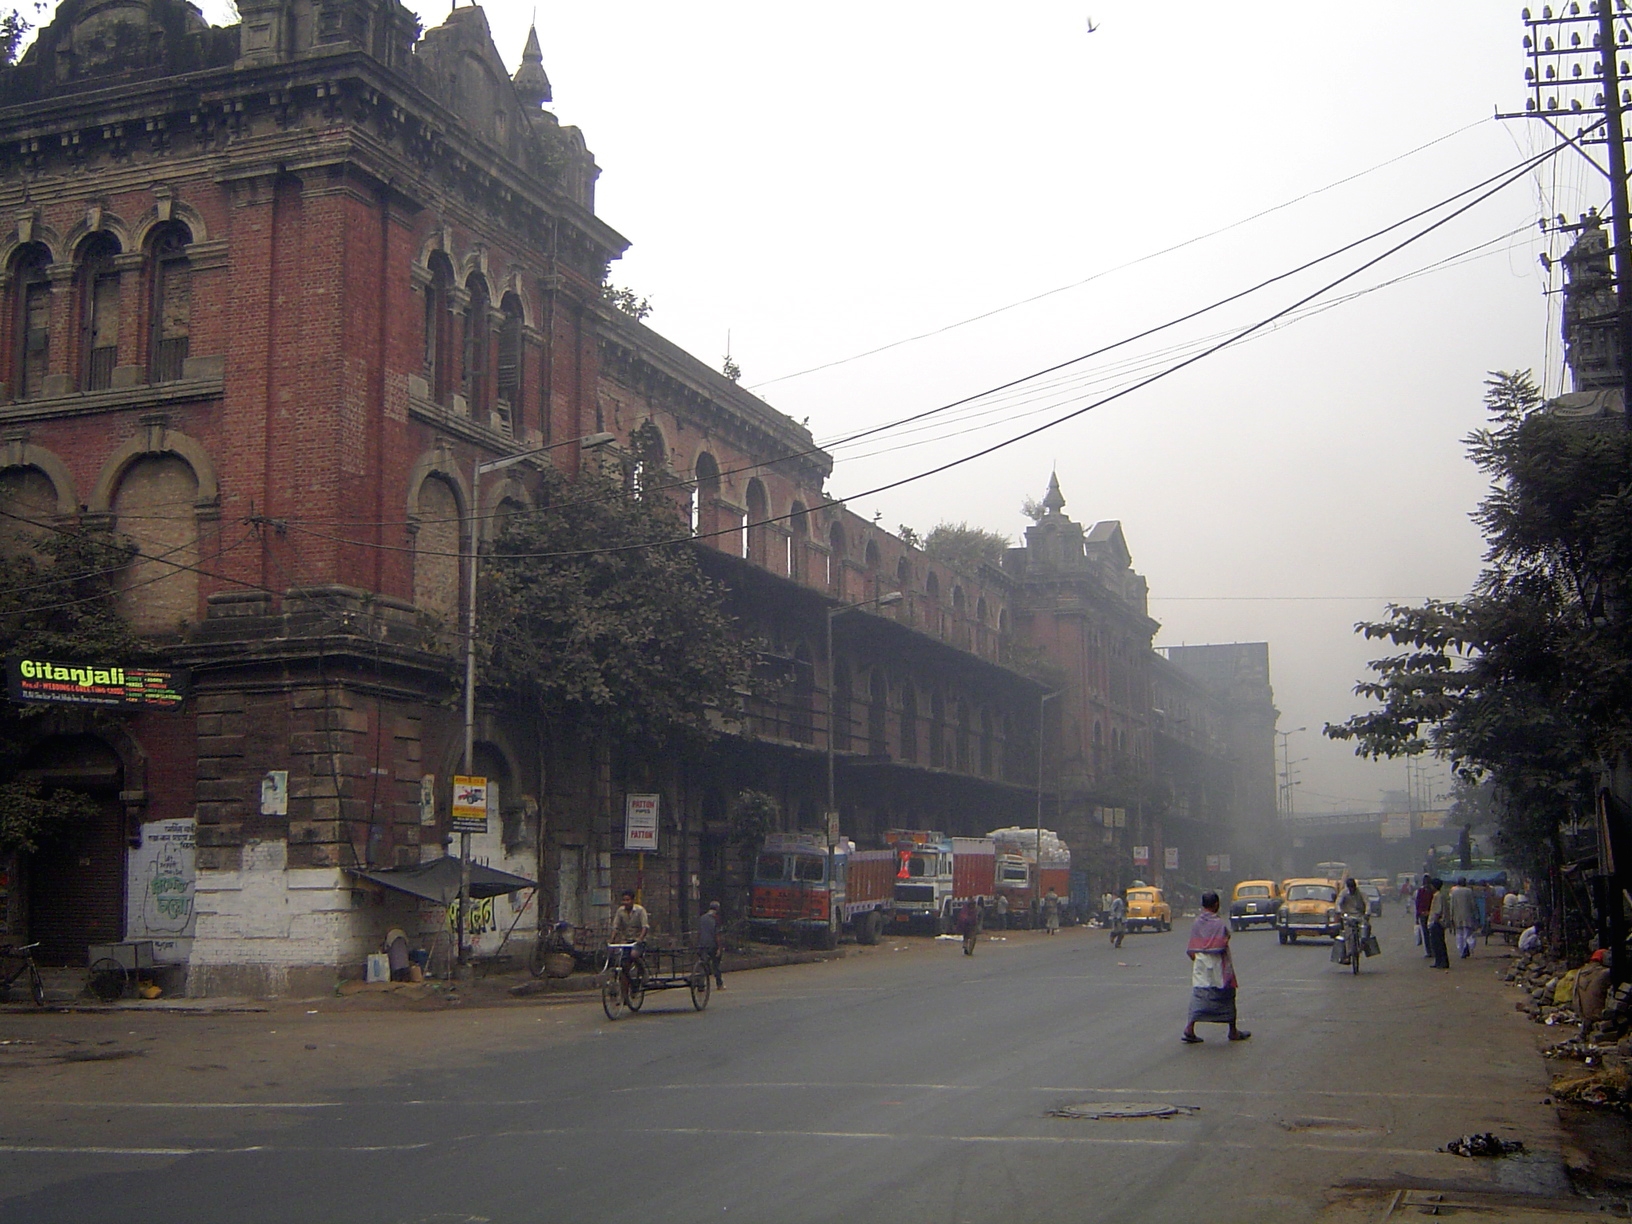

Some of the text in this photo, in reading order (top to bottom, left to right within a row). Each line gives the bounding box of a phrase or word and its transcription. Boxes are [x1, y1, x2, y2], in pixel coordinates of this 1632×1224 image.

[21, 660, 124, 686] Gitanjali
[632, 800, 655, 808] PATTON
[631, 830, 654, 839] PATTON
